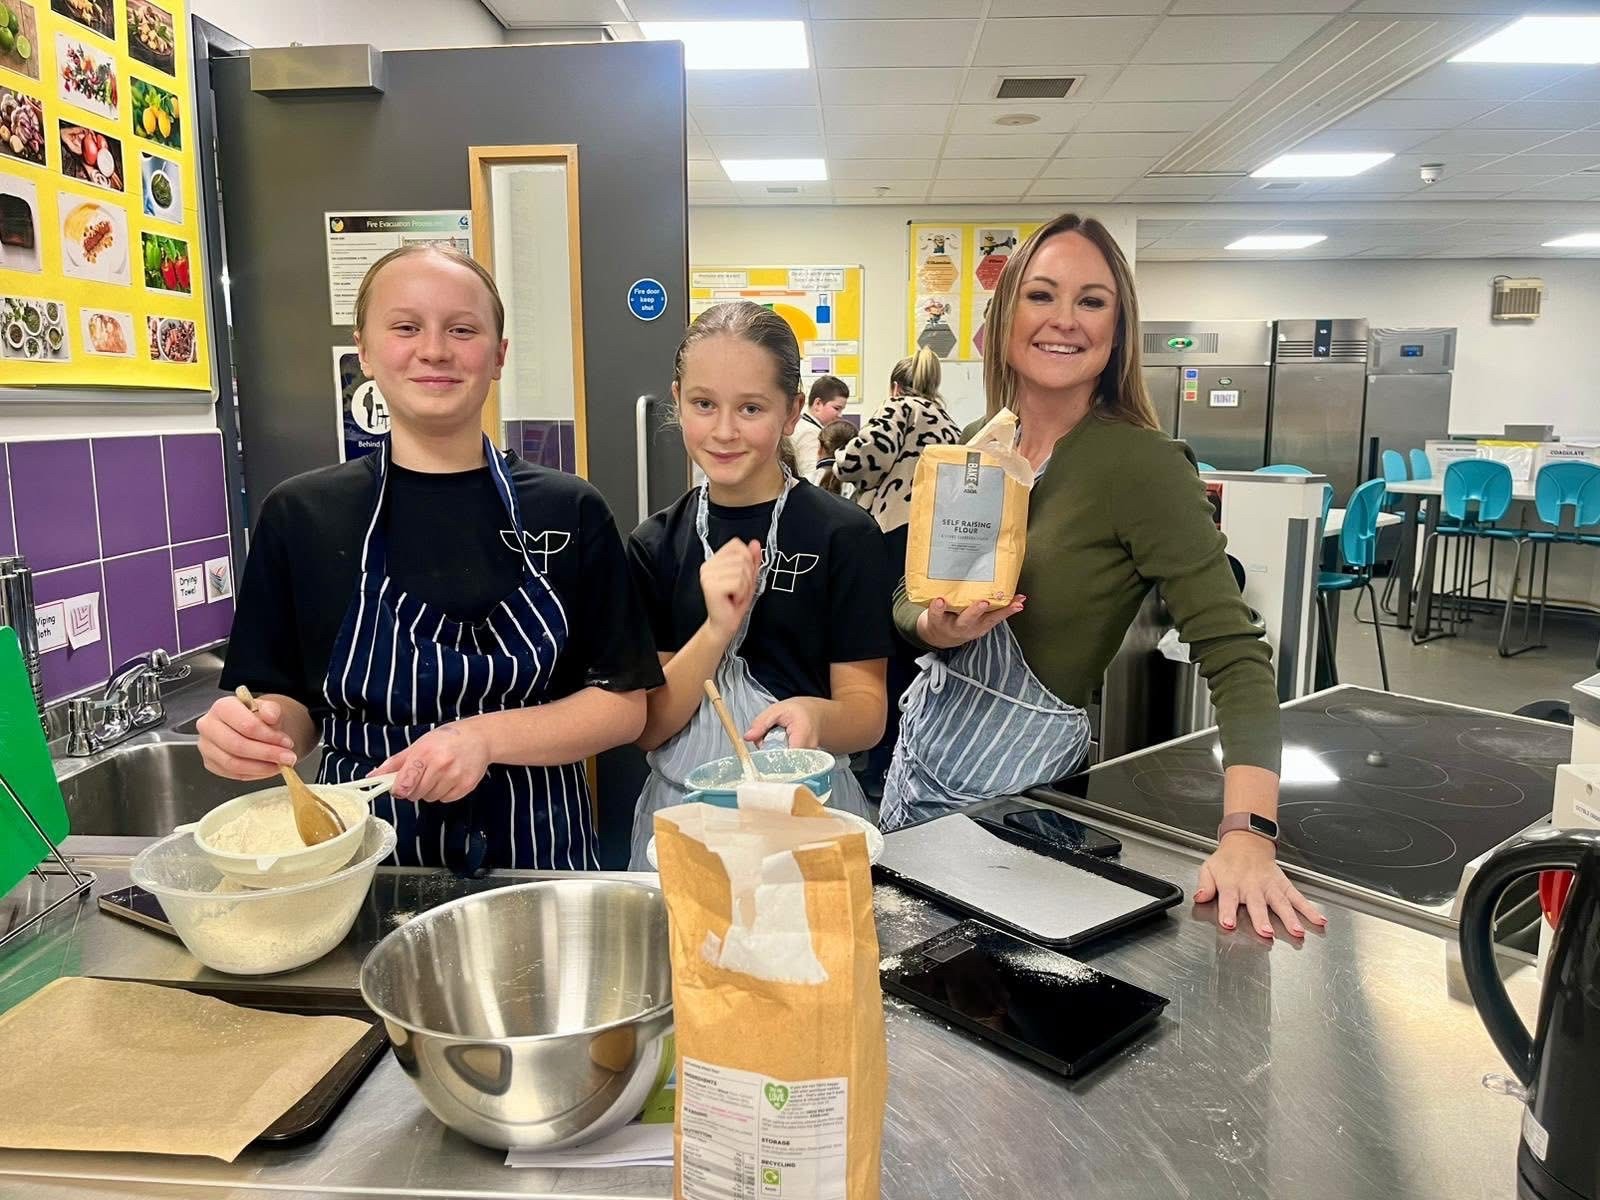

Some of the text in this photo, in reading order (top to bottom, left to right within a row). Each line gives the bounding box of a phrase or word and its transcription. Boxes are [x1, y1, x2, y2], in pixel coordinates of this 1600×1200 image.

[366, 220, 379, 228] Fire
[358, 440, 381, 448] Behind
[967, 462, 978, 483] BAKE
[942, 518, 992, 529] SELF RAISING
[954, 526, 978, 534] FLOUR
[179, 575, 197, 586] Drying
[180, 586, 196, 597] Towel
[38, 628, 52, 639] loth
[761, 1137, 791, 1146] STORAGE
[761, 1159, 796, 1168] RECYCLING
